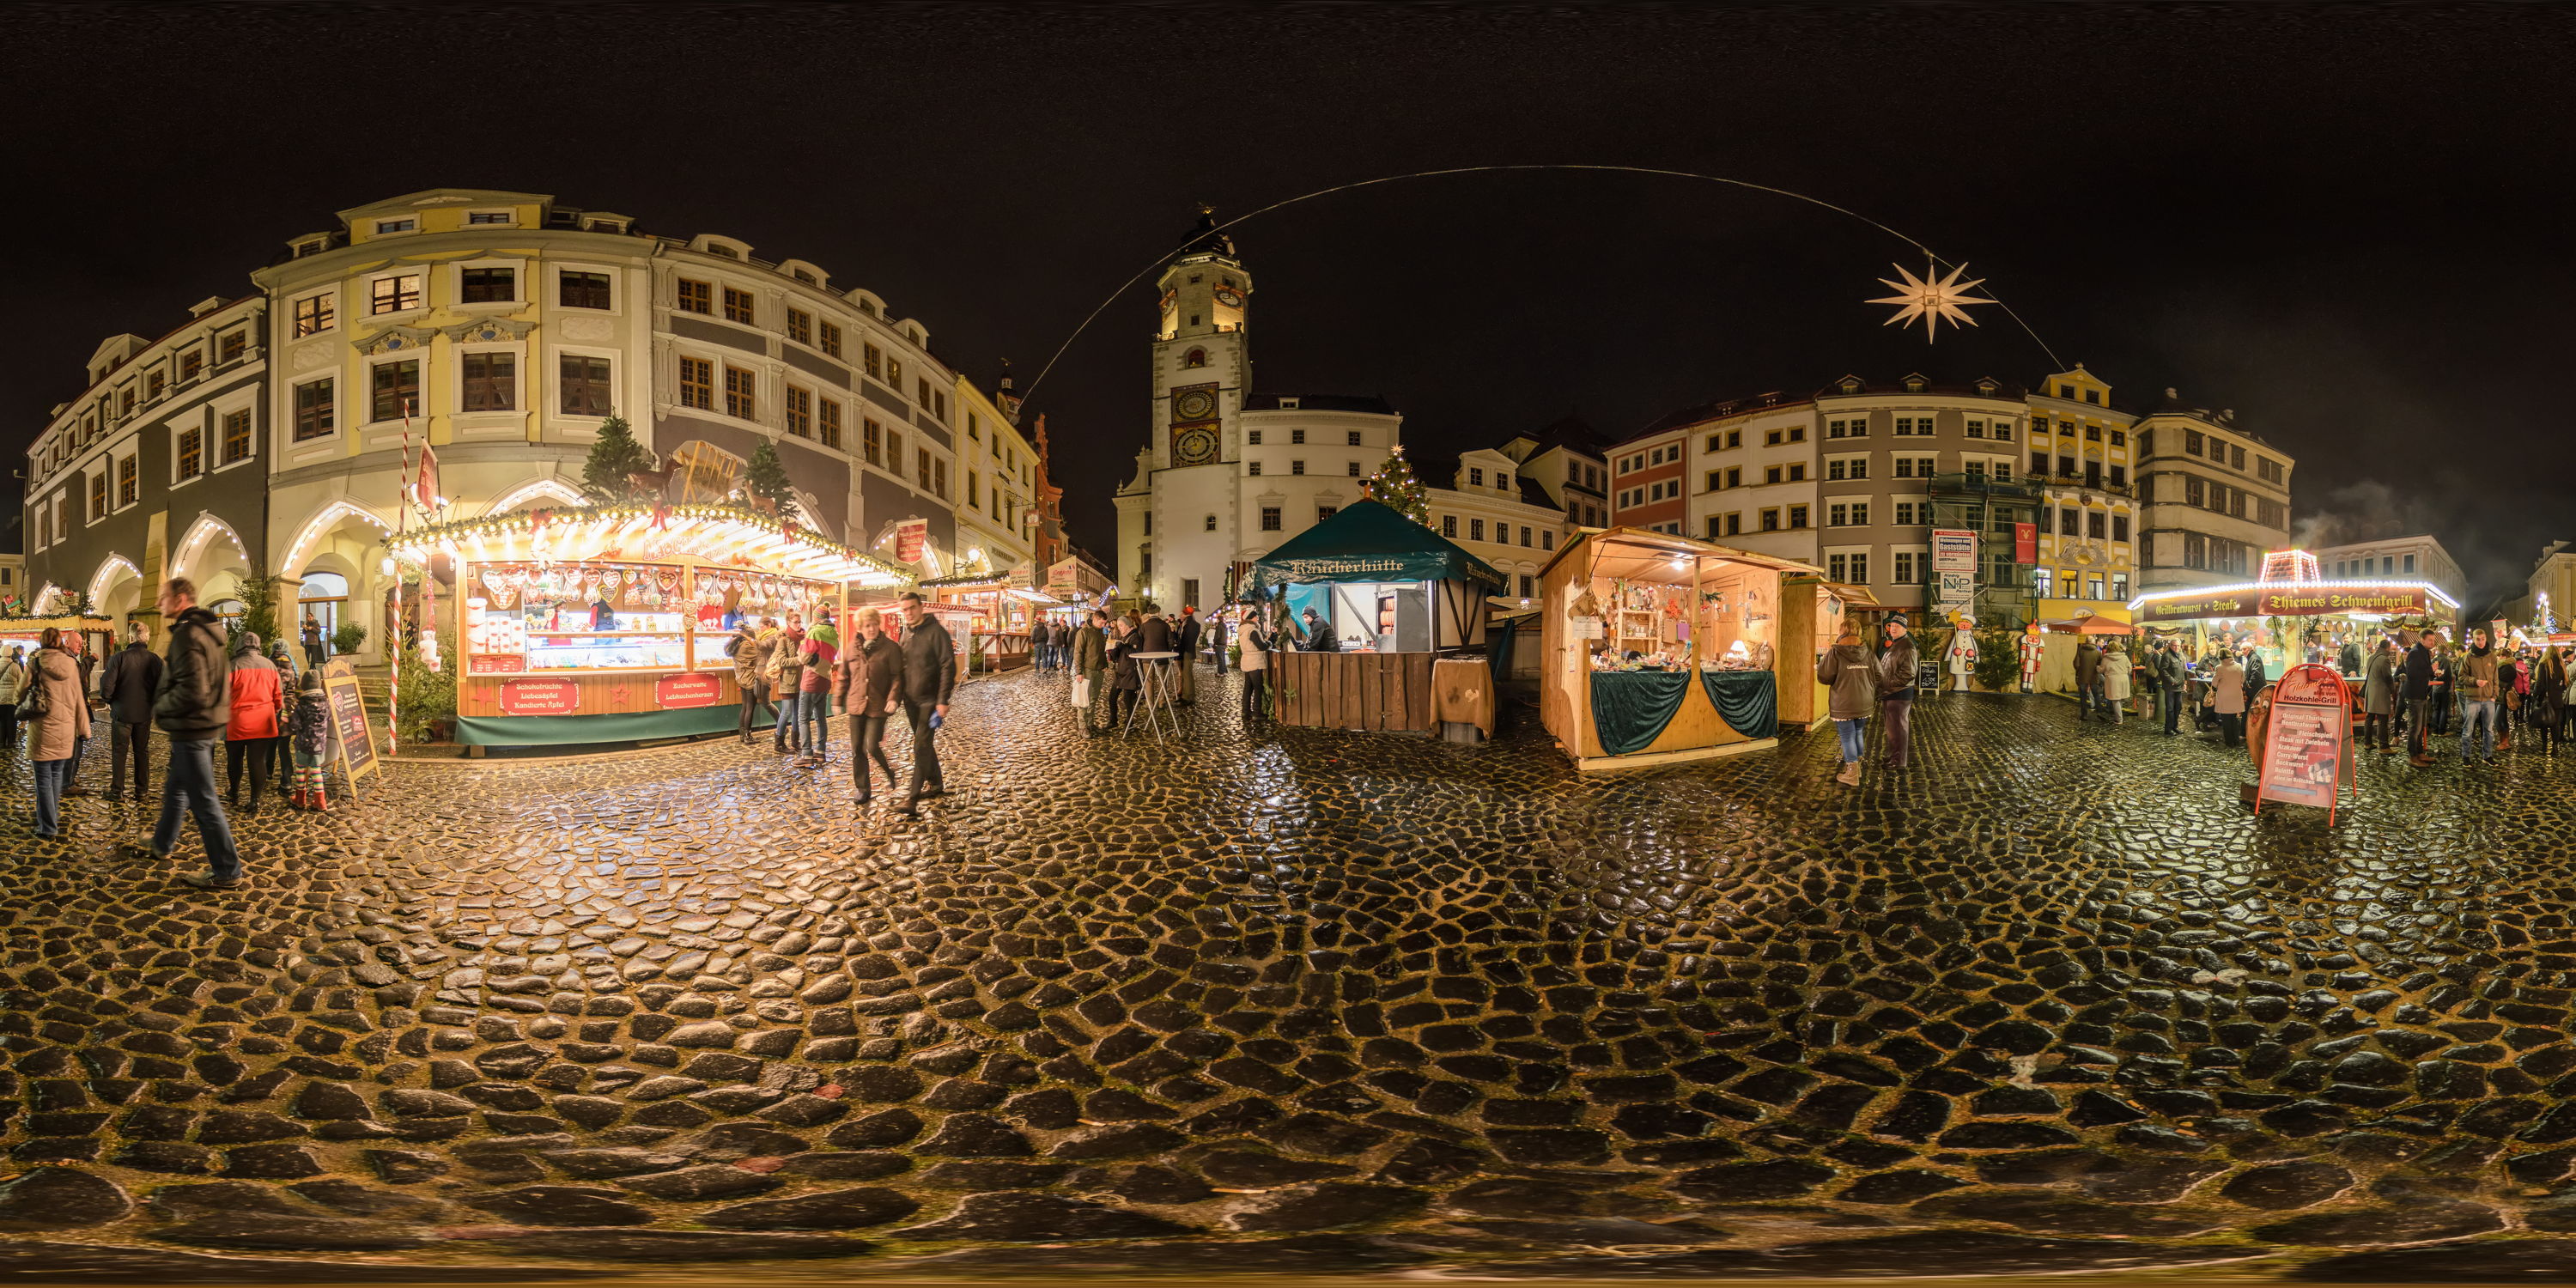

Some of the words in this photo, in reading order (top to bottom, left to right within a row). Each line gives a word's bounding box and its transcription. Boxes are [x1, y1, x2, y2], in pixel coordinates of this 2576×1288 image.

[1939, 543, 1971, 551] Gaststätte
[1291, 559, 1404, 575] Räucherhütte
[2269, 595, 2326, 611] Thiemes
[2330, 594, 2414, 611] Schwenkgrill
[2155, 604, 2202, 617] Grillbratwurst
[2212, 598, 2239, 612] Steaks
[2283, 695, 2336, 704] Holzkohle-Grill
[2281, 720, 2321, 728] Rostbratwurst
[2276, 751, 2309, 760] Curry-Wurst
[2275, 759, 2304, 768] Bockwurst
